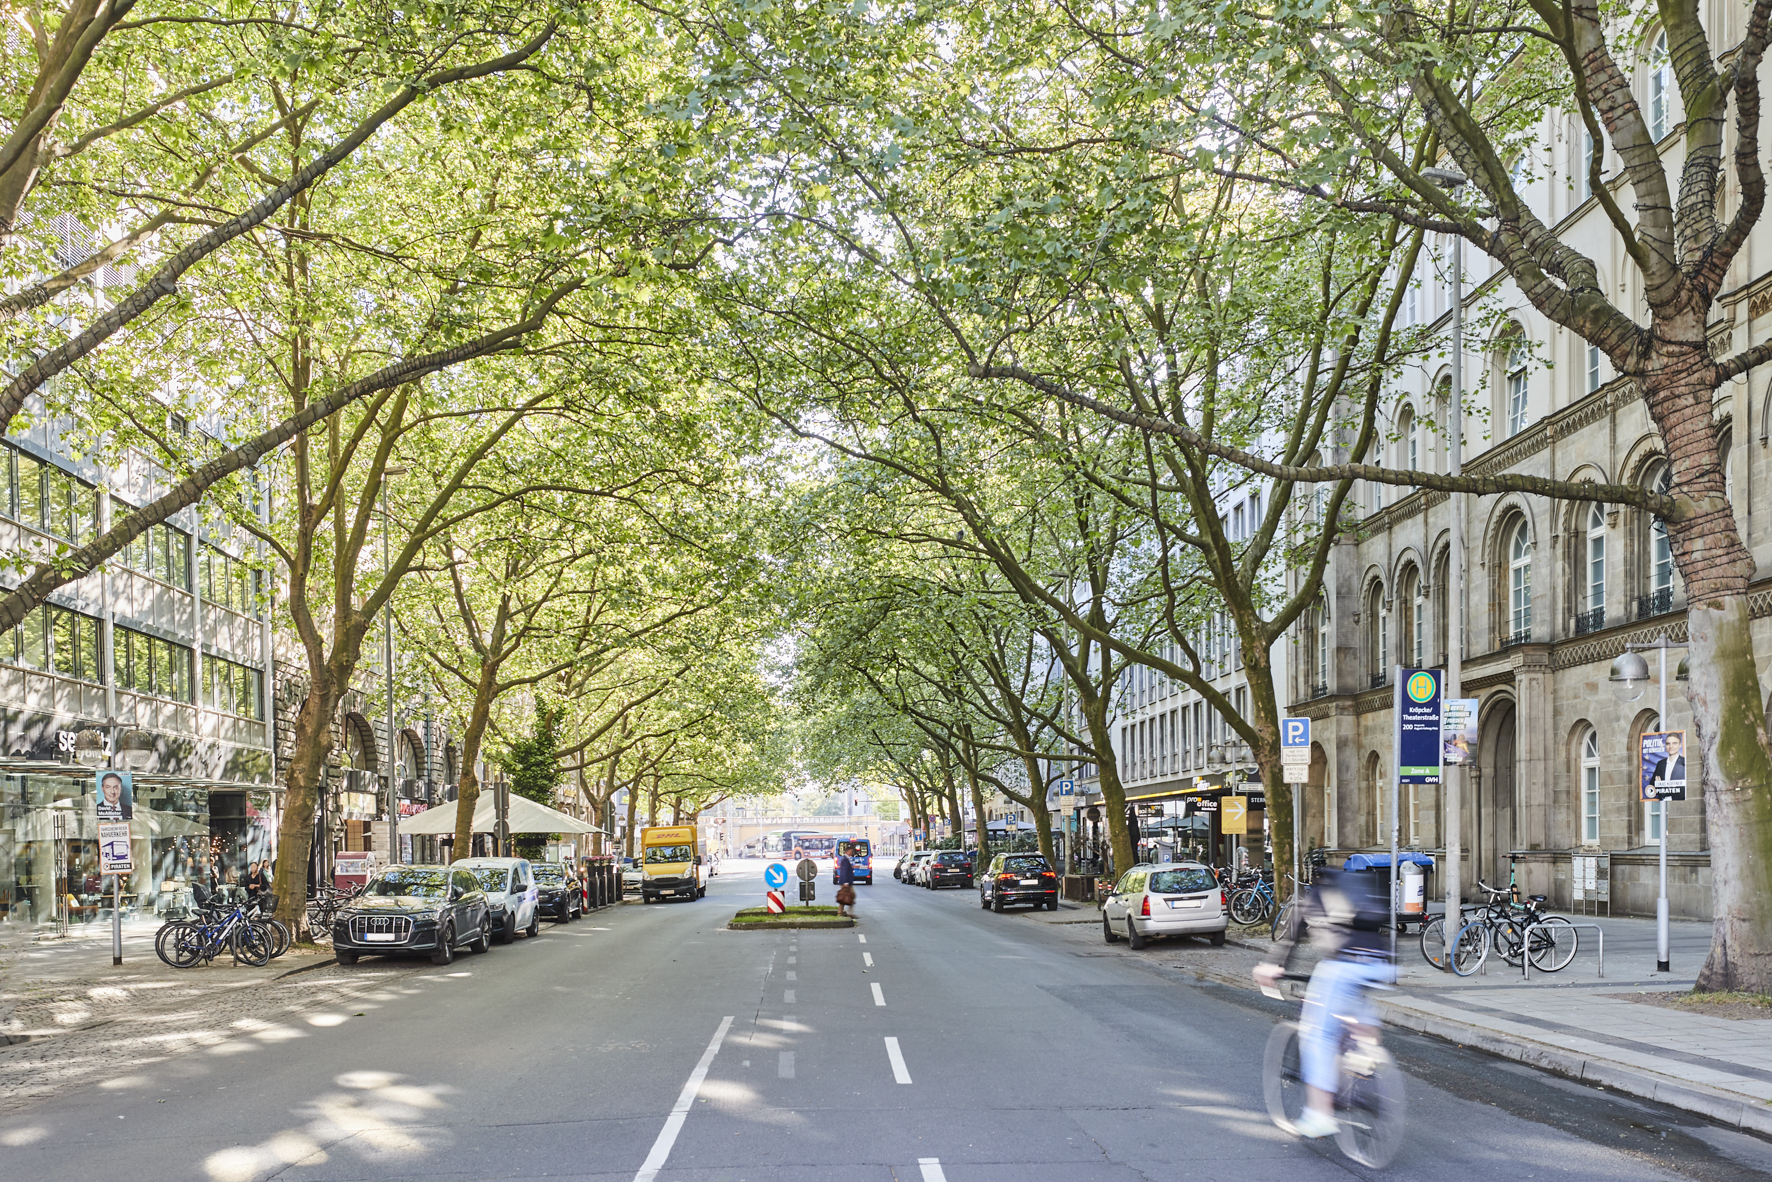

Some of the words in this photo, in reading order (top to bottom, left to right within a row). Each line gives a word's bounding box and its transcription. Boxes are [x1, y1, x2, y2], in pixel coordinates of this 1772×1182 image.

[1415, 679, 1427, 696] H
[1287, 721, 1304, 744] P
[1643, 737, 1664, 748] POLITIK
[1062, 781, 1071, 795] P
